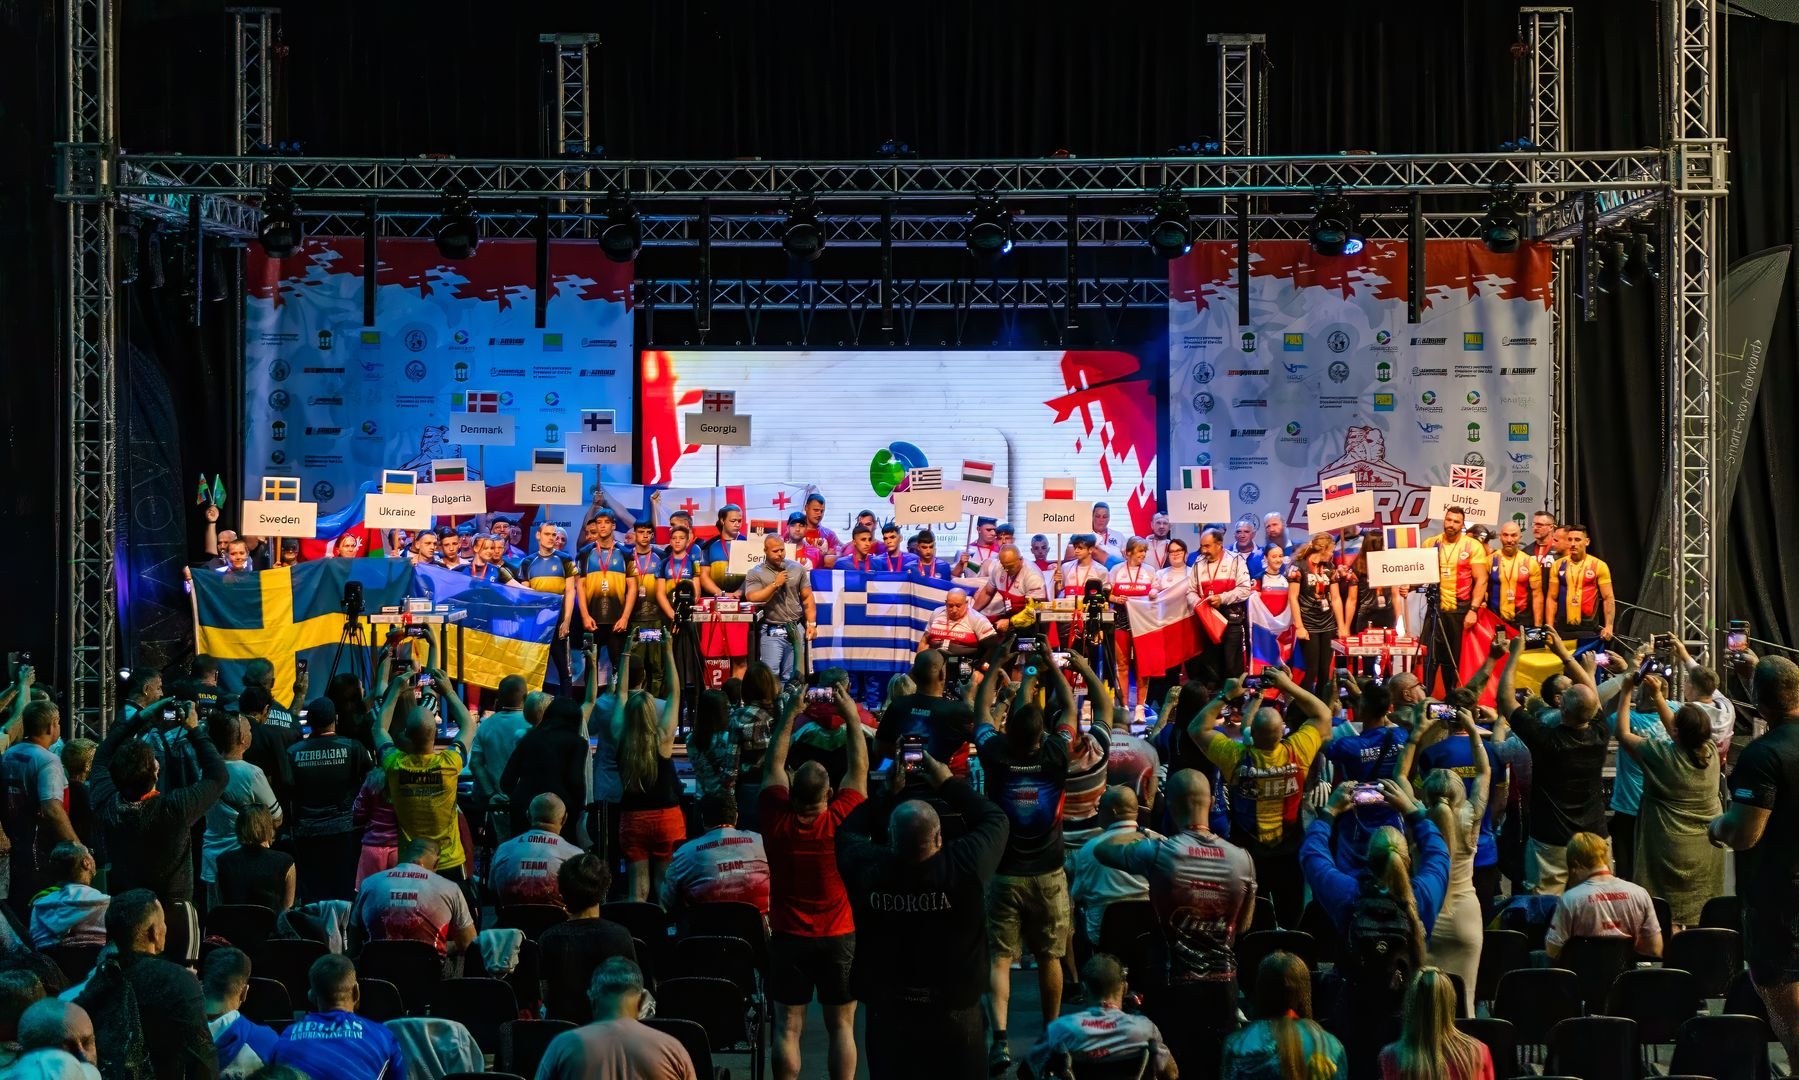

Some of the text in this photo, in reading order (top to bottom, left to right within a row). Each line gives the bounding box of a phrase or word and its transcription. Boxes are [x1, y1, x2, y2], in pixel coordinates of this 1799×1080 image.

[460, 424, 503, 435] Denmark
[699, 422, 738, 436] Georgia
[580, 444, 617, 454] Finland
[530, 483, 567, 495] Estonia
[431, 492, 472, 505] Bulgaria
[961, 493, 995, 507] ungary
[1450, 494, 1479, 506] Unite
[378, 505, 416, 518] Ukraine
[909, 503, 945, 514] Greece
[1186, 500, 1208, 513] Italy
[1293, 490, 1431, 524] ERO
[1320, 505, 1361, 521] Slovakia
[1443, 504, 1486, 518] Kdom
[258, 512, 301, 526] Sweden
[1042, 512, 1075, 523] Poland
[1381, 562, 1425, 574] Romania
[712, 669, 723, 686] 2
[294, 747, 348, 763] AZERBAIJAN
[520, 860, 548, 870] TEAM
[717, 860, 744, 873] TEAM
[390, 891, 418, 901] TEAM
[870, 891, 953, 913] GEORGIA
